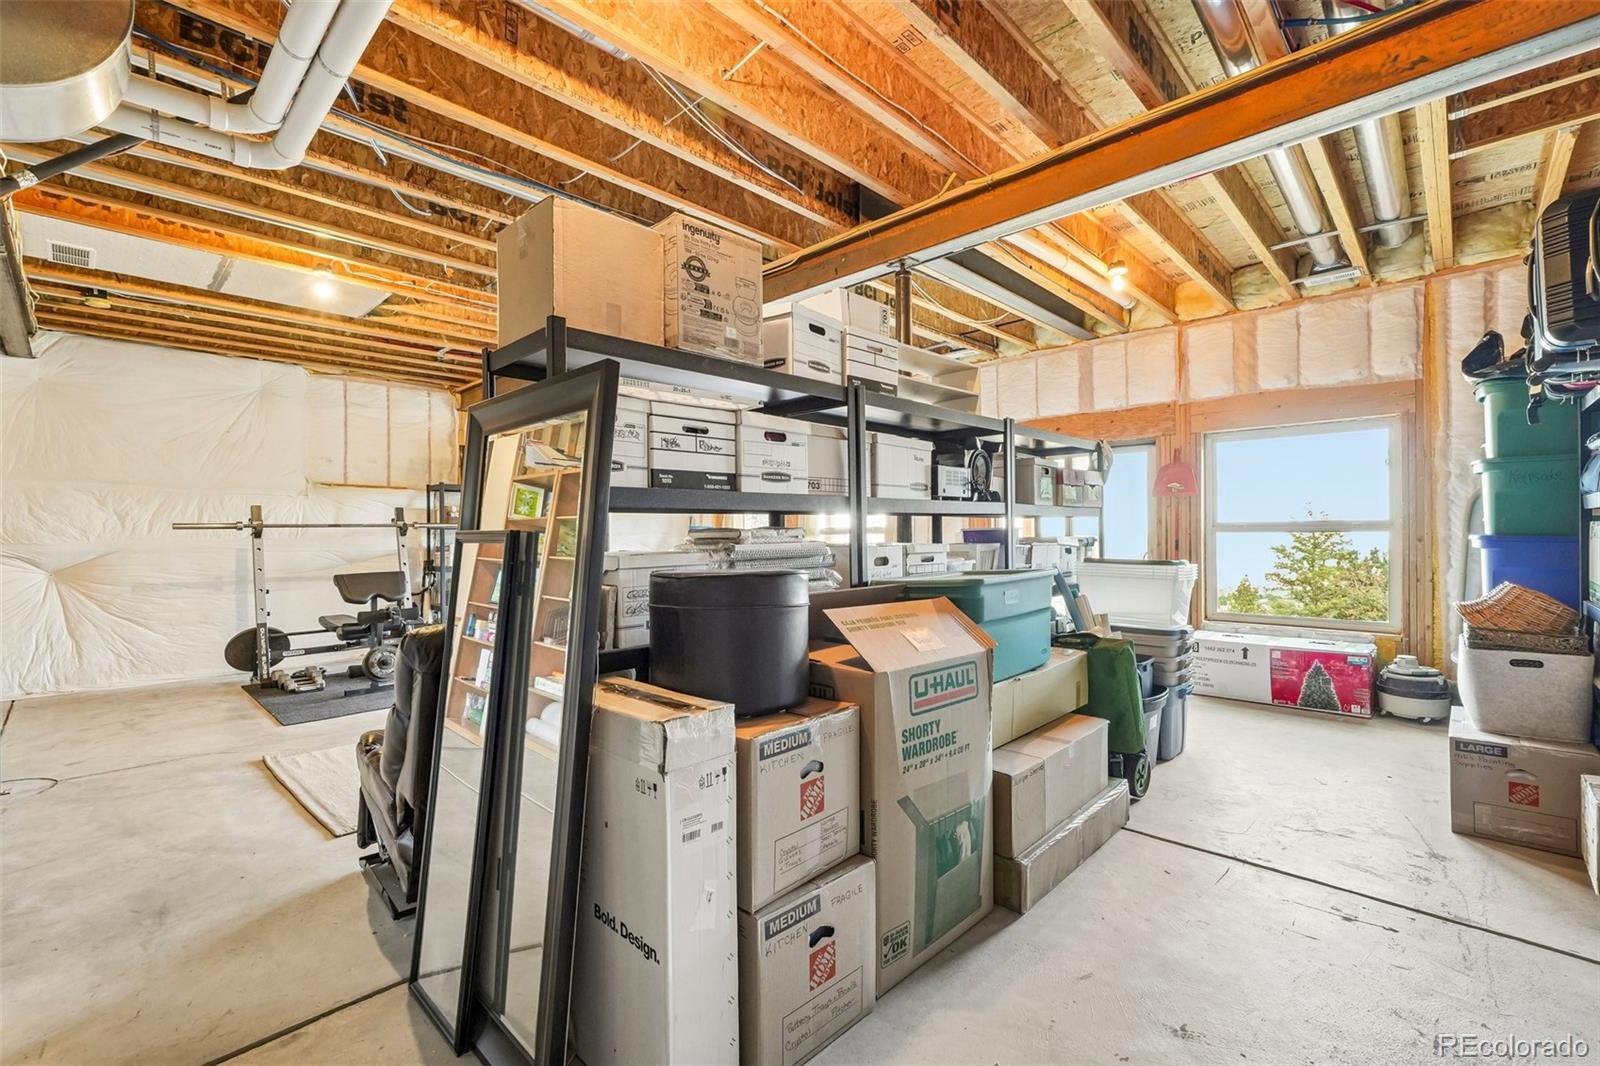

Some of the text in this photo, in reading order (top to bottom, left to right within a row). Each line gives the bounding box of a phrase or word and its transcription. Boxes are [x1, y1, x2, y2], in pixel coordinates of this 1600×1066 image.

[682, 218, 720, 245] ingenuity
[914, 668, 972, 699] U-HAUL
[763, 731, 809, 757] MEDIUM
[822, 726, 856, 743] FRAGILE
[902, 719, 941, 745] SHORTY
[902, 730, 957, 762] WARDROBE
[1460, 743, 1505, 756] LARGE
[759, 752, 805, 776] KITCHEN
[830, 883, 864, 908] FRAGILE
[769, 899, 818, 935] MEDIUM
[594, 903, 660, 965] Bold. Design.
[765, 925, 808, 957] KITCHEN
[892, 936, 907, 953] OK
